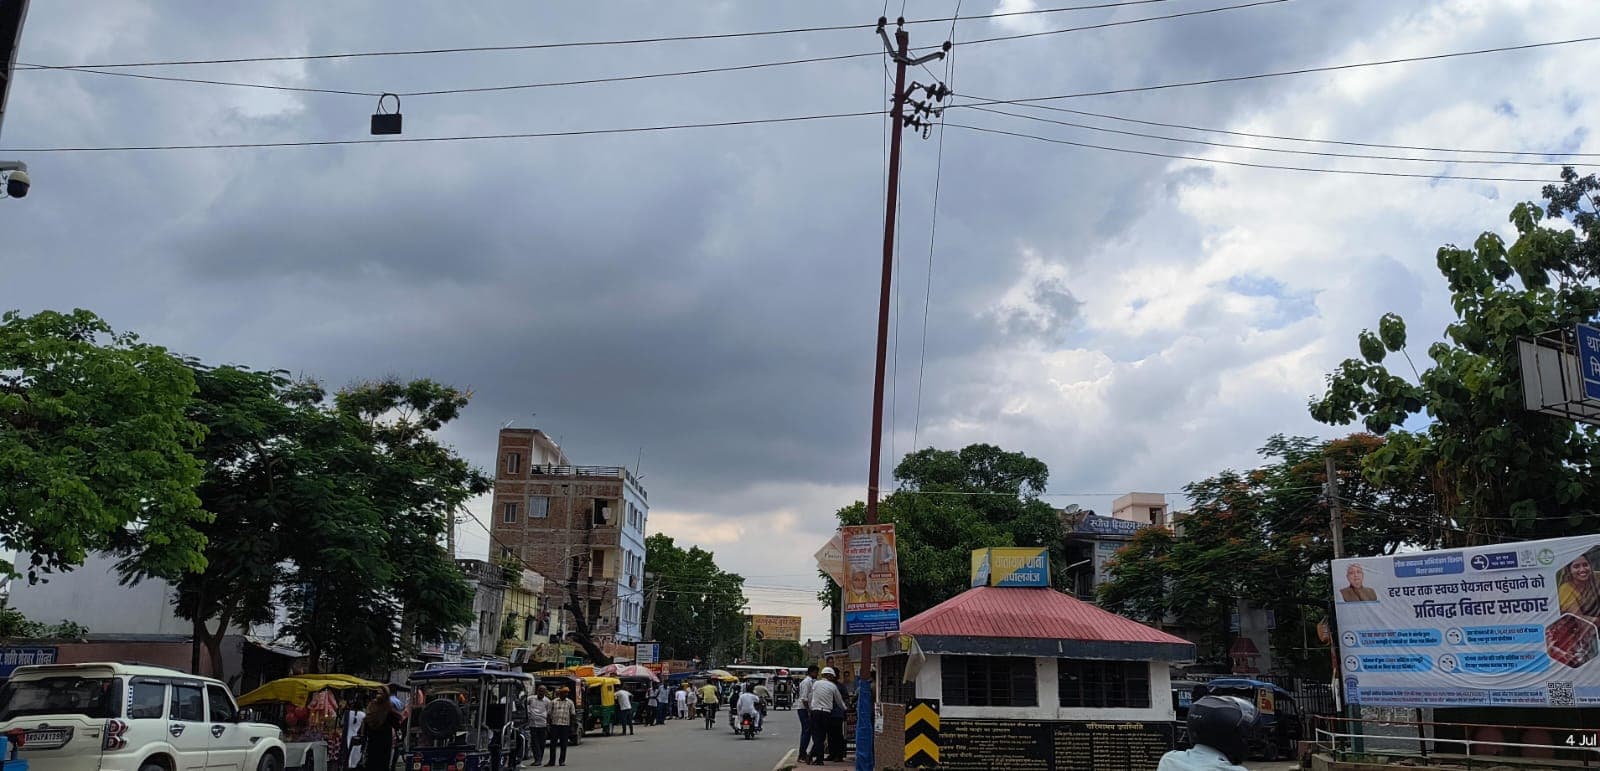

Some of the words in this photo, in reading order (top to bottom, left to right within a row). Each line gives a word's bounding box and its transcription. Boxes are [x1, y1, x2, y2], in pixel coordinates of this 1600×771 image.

[1387, 586, 1400, 598] हर
[1402, 586, 1415, 596] घर
[1417, 584, 1433, 596] तक
[1434, 582, 1459, 595] स्वच्छ
[1460, 579, 1494, 592] पेयजल
[1495, 576, 1529, 593] पहुंचाने
[1530, 574, 1545, 588] को
[1413, 600, 1457, 619] प्रतिबद्ध
[1458, 598, 1496, 616] बिहार
[1497, 597, 1549, 614] सरकार
